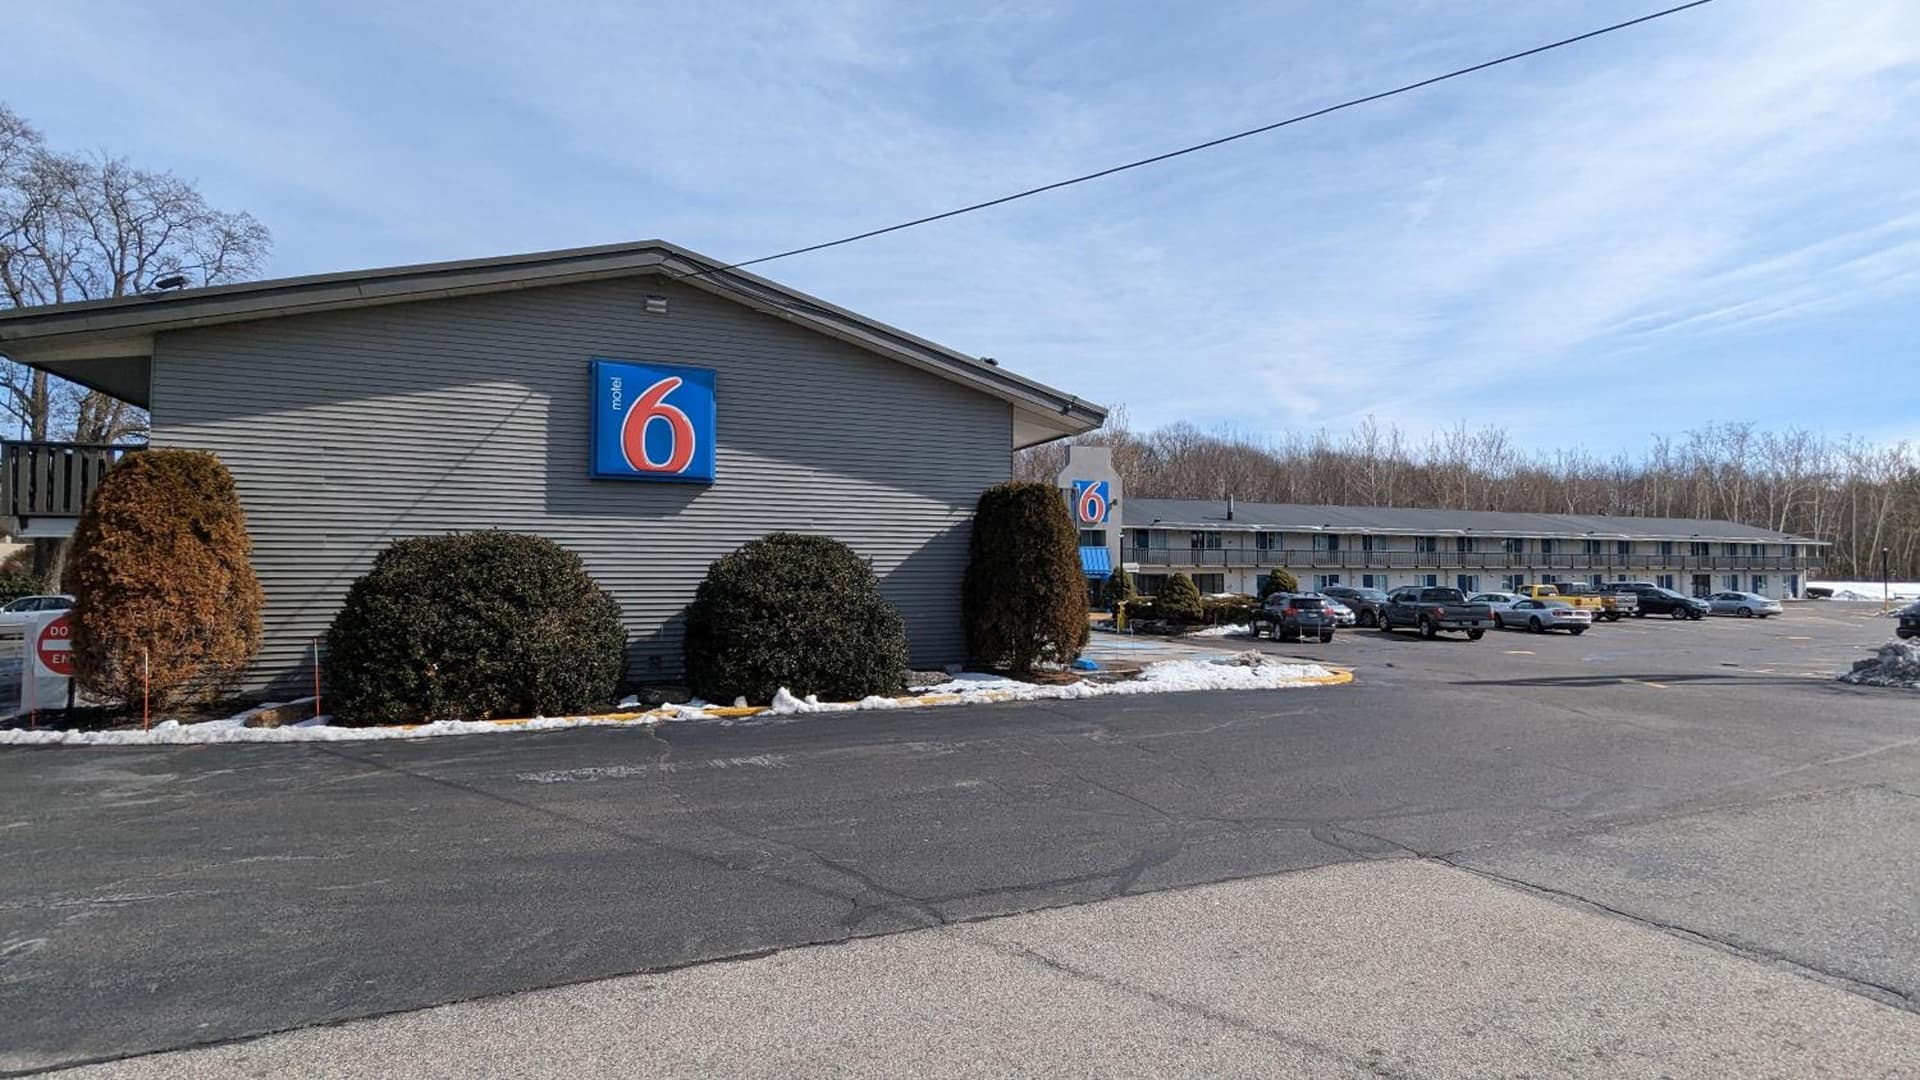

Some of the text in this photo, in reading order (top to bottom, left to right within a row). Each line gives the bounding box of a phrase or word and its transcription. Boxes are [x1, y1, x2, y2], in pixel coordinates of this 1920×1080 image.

[610, 376, 696, 474] motel 6
[1079, 480, 1106, 523] 6
[50, 626, 69, 636] DO
